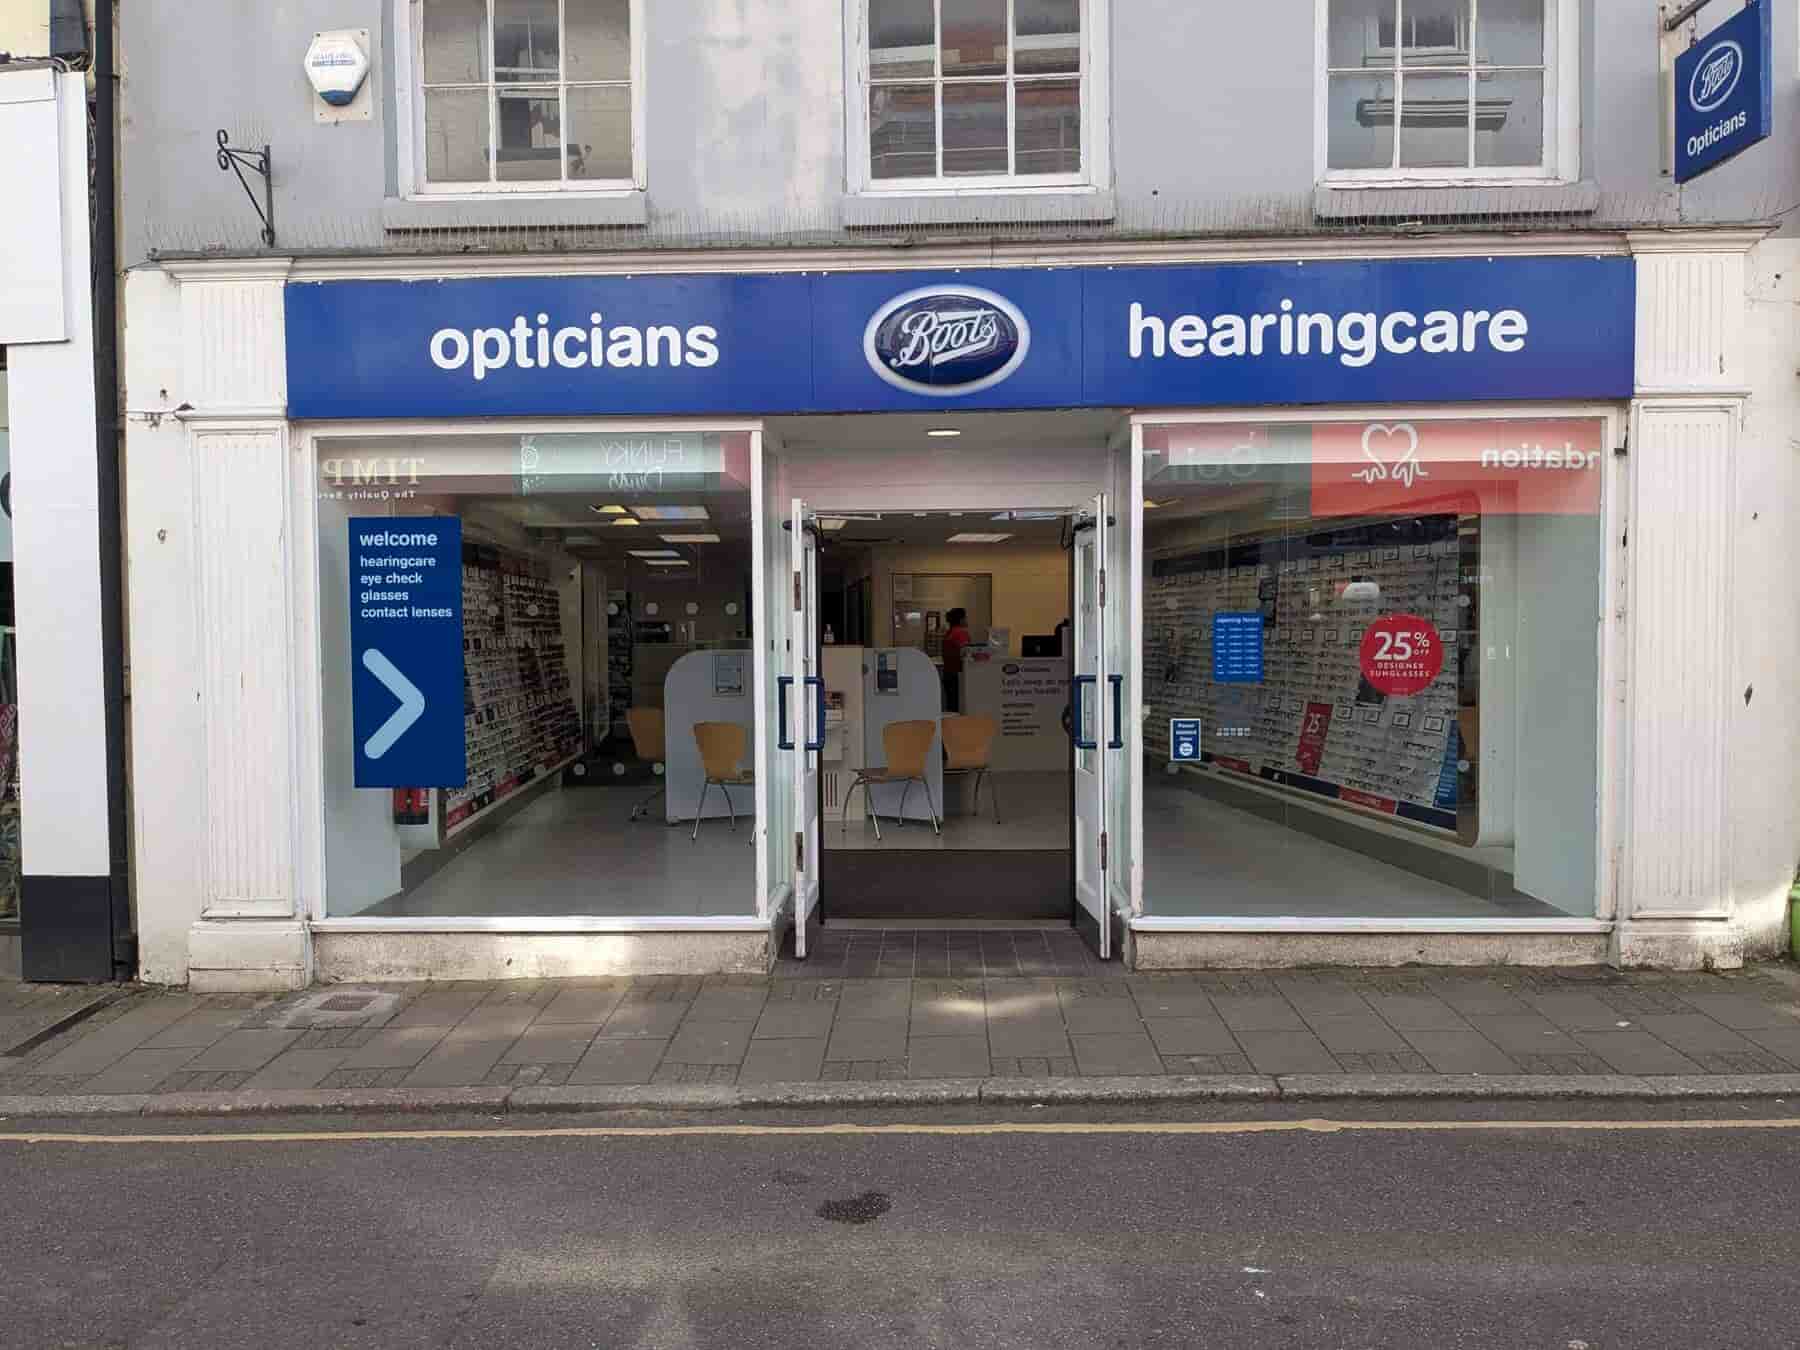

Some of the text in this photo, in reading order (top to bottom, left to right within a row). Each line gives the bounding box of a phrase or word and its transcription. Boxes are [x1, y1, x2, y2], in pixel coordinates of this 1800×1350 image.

[1697, 49, 1734, 102] Boots
[1687, 111, 1746, 156] Opticians
[430, 312, 719, 380] opticians
[890, 308, 997, 368] Boots
[1129, 299, 1528, 367] hearingcare
[360, 531, 438, 546] welcome
[360, 555, 436, 569] hearingcare
[360, 572, 423, 587] eye check
[360, 589, 409, 603] glasses
[361, 606, 453, 618] contact lenses
[1374, 631, 1430, 660] 25%
